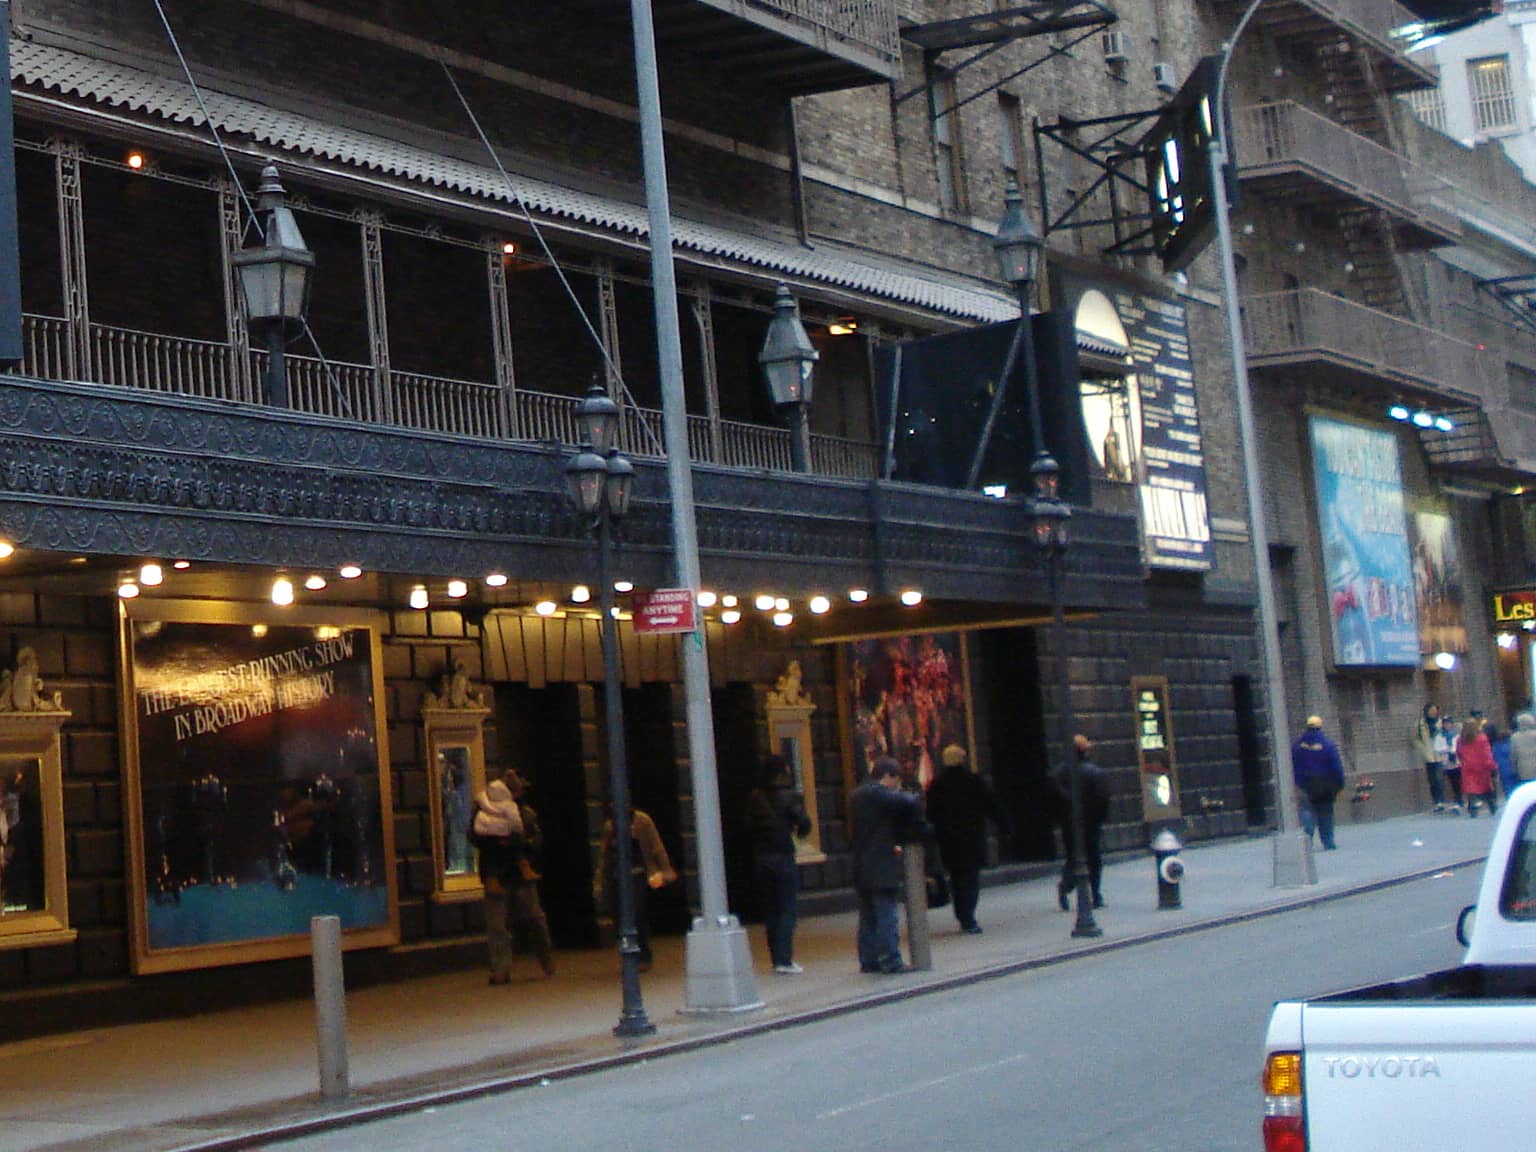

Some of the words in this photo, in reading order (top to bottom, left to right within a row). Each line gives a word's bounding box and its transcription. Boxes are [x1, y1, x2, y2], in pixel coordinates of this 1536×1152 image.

[141, 687, 175, 715] THE
[314, 634, 354, 667] SHOW
[174, 712, 191, 740] IN
[195, 689, 273, 734] BROADWAY
[1323, 1056, 1441, 1078] TOYOTA
